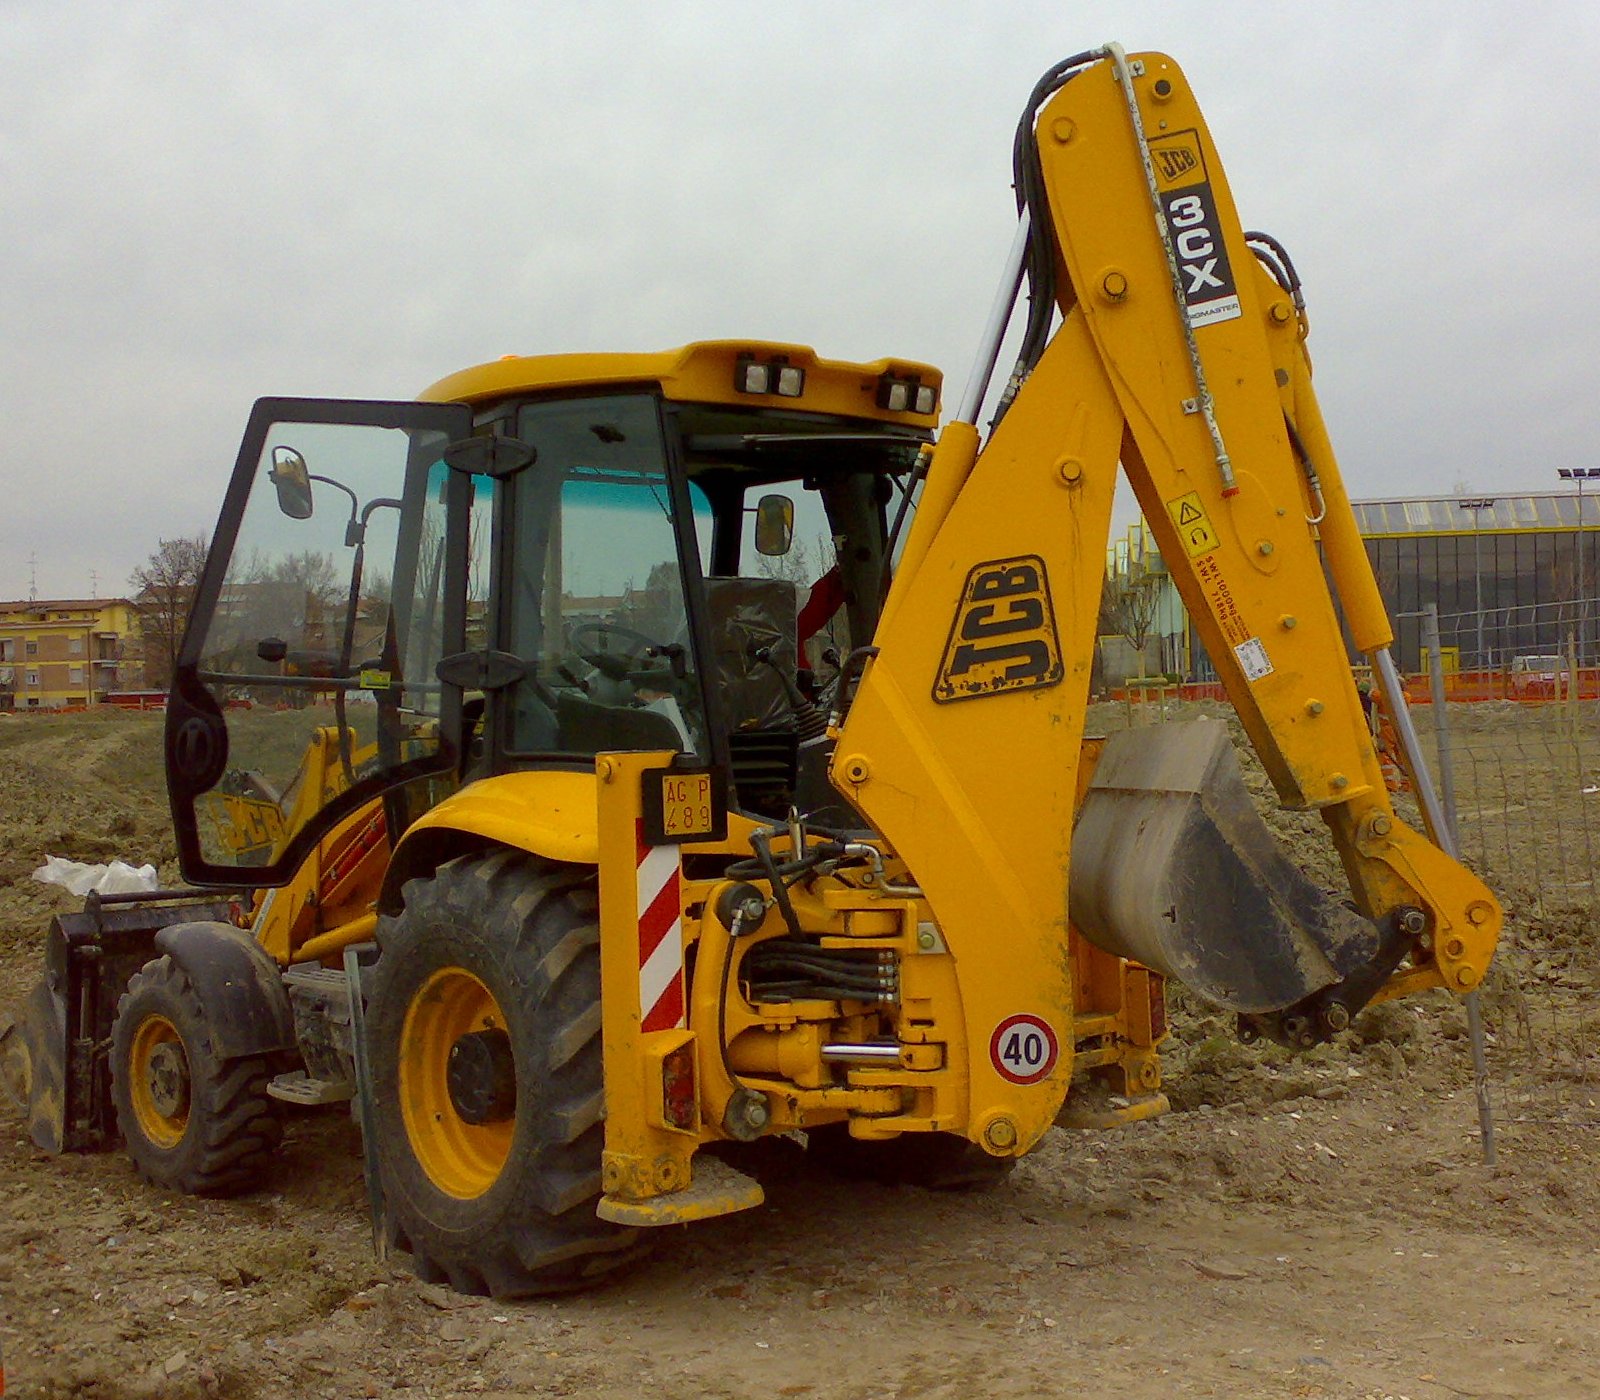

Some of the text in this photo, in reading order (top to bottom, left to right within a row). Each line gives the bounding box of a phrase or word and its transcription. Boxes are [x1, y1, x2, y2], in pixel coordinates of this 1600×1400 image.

[1159, 151, 1194, 178] JCB
[1169, 195, 1225, 295] 3CX
[1189, 303, 1239, 319] ROMASTER
[949, 565, 1050, 681] JCB
[667, 779, 708, 802] AG P
[1003, 1032, 1043, 1066] 40
